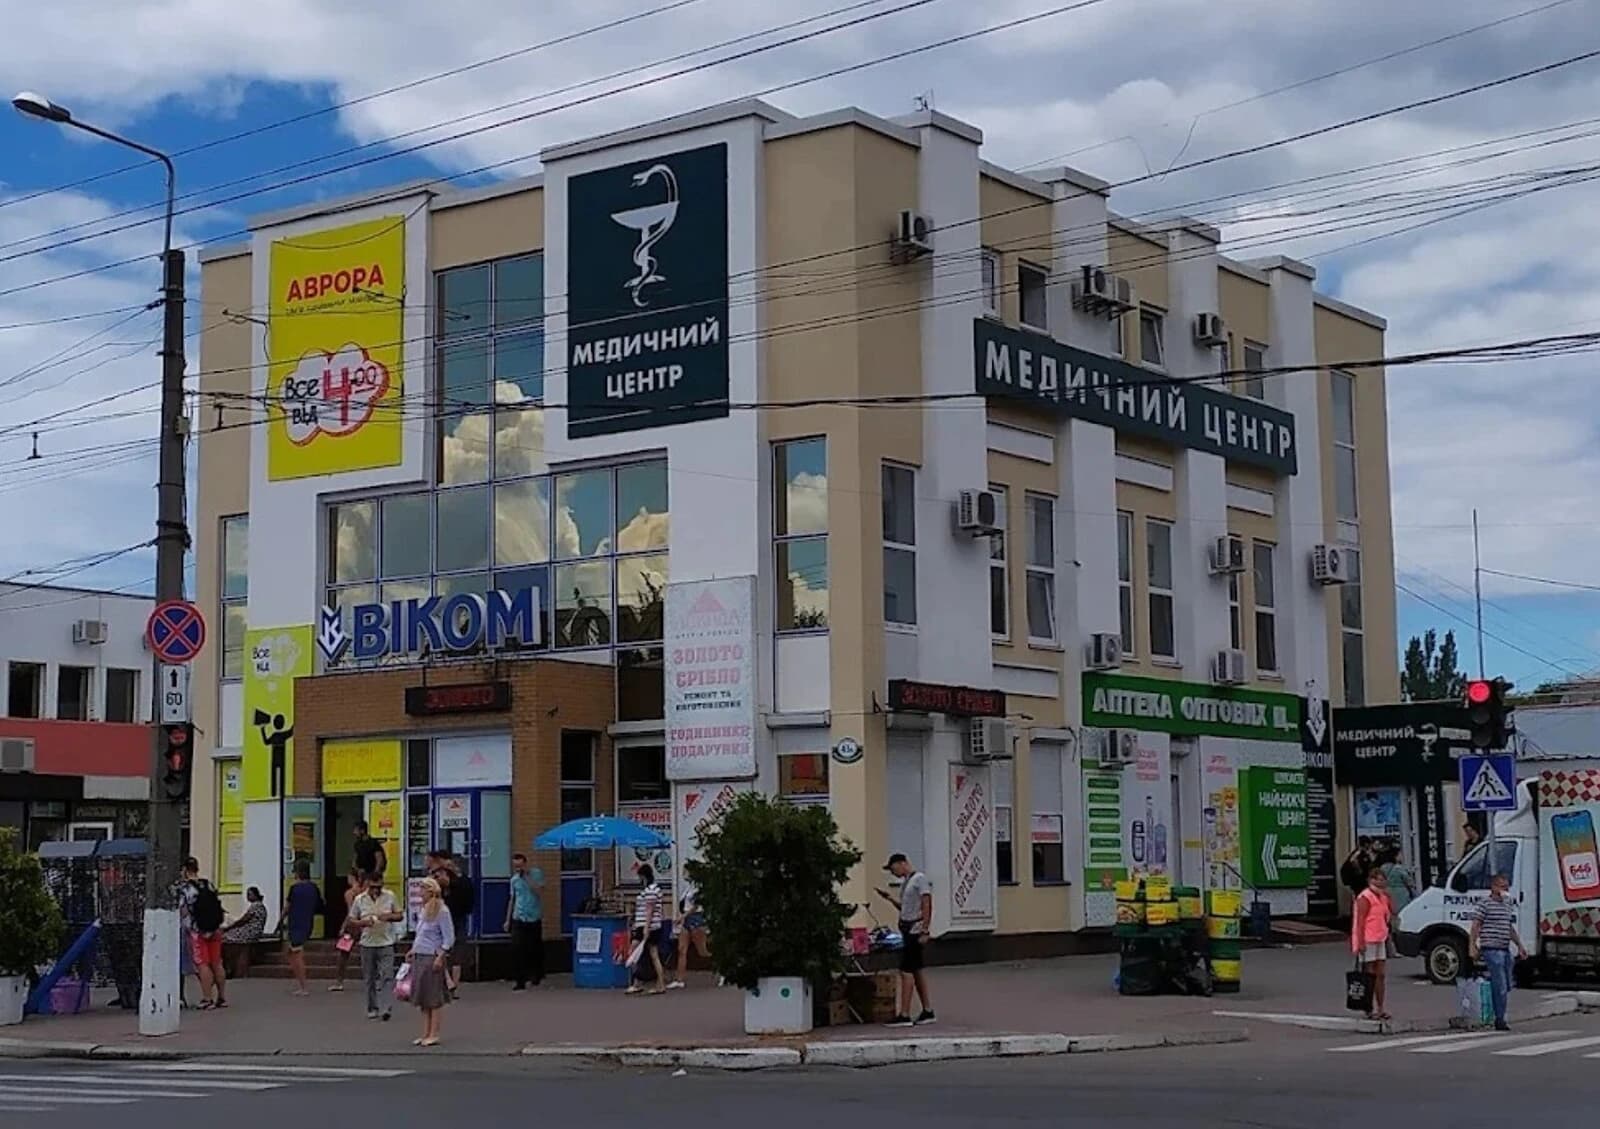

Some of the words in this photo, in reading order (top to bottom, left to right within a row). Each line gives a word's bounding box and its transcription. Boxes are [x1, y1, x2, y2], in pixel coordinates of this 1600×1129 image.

[286, 264, 385, 303] АВРОРА
[572, 316, 720, 367] МЕДИЧНИЙ
[606, 364, 684, 399] ЦЕНТР
[323, 367, 351, 425] 4
[985, 340, 1187, 432] МЕДИЧНИЙ
[1204, 403, 1292, 458] ЦЕНТР
[353, 585, 541, 660] ВІКОМ
[672, 644, 744, 665] ЗОЛОТО
[676, 668, 741, 688] СРІБЛО
[166, 691, 183, 707] 60
[684, 691, 717, 700] РЕМОНТ
[719, 690, 731, 699] ТА
[1092, 688, 1174, 719] АПТЕКА
[1181, 696, 1267, 727] ОПТОВИХ
[1336, 725, 1415, 742] МЕДИЧНИЙ
[671, 743, 750, 758] ПОДАРУНКИ
[1355, 745, 1397, 758] ЦЕНТР
